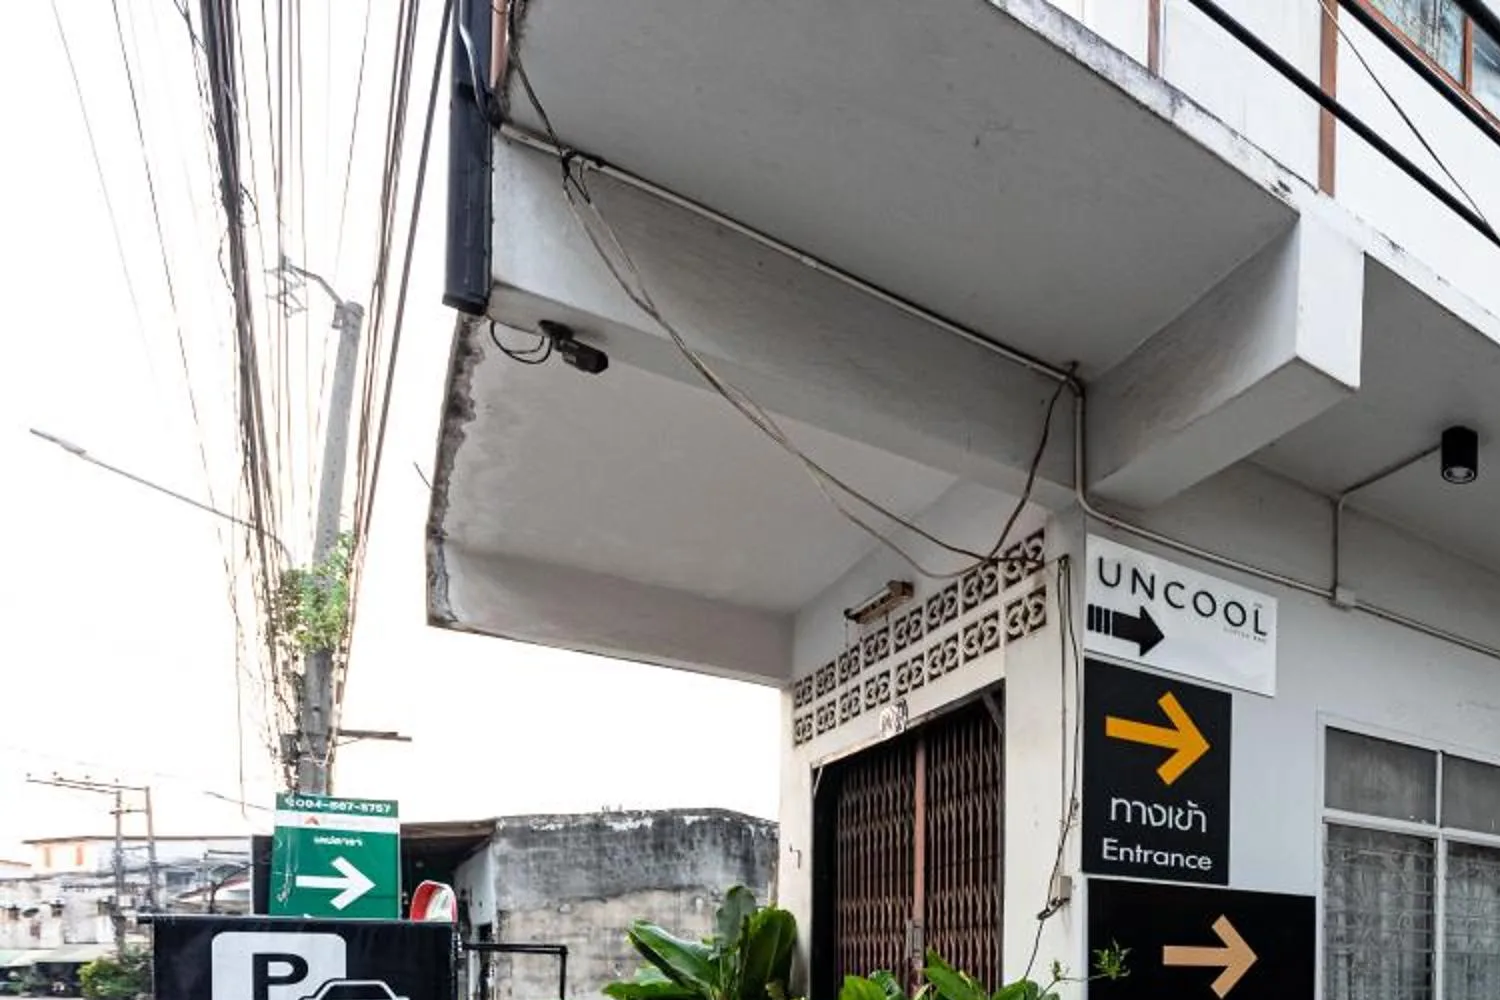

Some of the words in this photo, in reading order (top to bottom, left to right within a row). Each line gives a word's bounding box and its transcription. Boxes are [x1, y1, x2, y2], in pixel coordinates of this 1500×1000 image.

[1098, 556, 1267, 636] UNCOOL
[1110, 796, 1208, 833] ทางเข้า
[1102, 838, 1212, 871] Entrance
